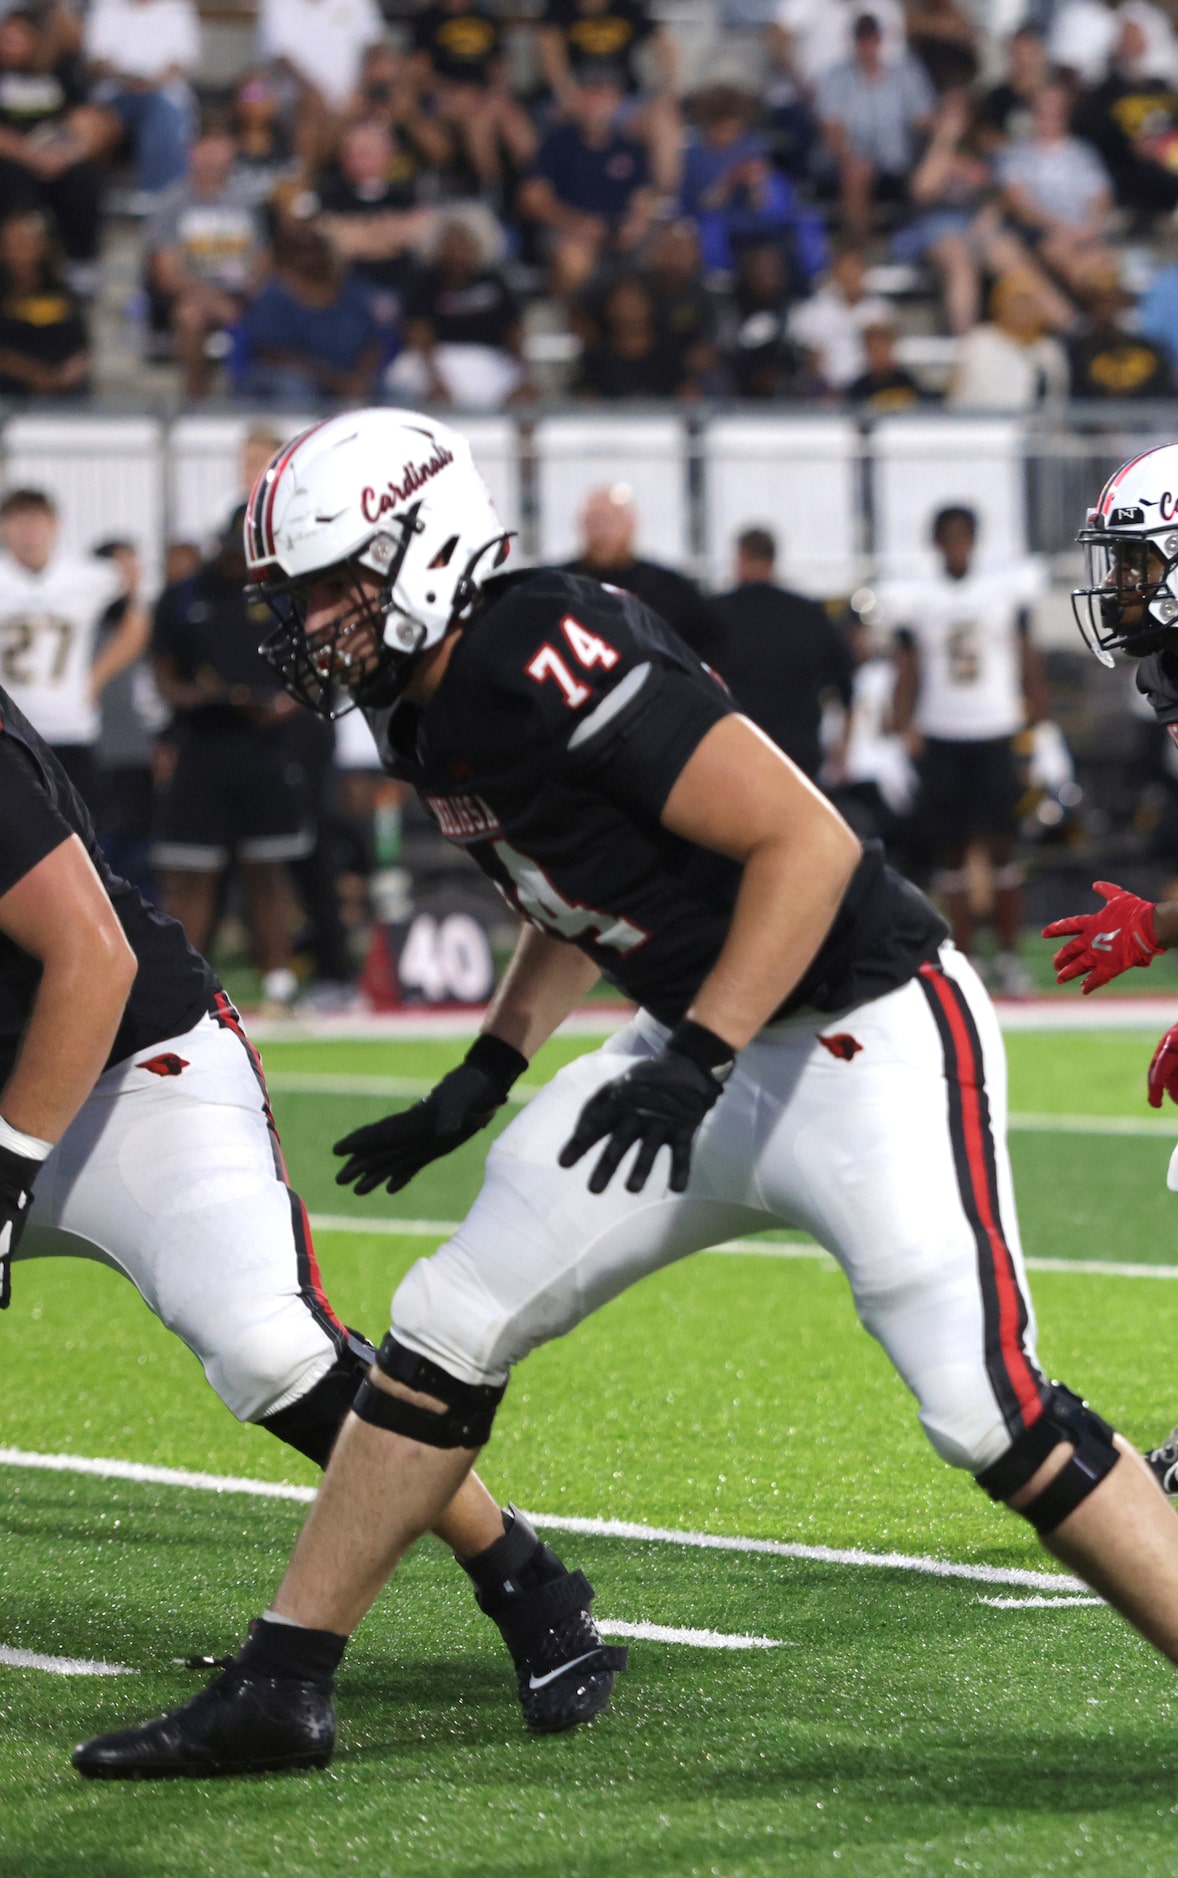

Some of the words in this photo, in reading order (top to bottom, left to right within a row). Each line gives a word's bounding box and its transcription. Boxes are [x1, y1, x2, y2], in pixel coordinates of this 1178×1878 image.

[360, 444, 455, 524] Cardinals
[0, 610, 76, 688] 27
[523, 613, 622, 710] 74
[398, 912, 494, 1003] 40
